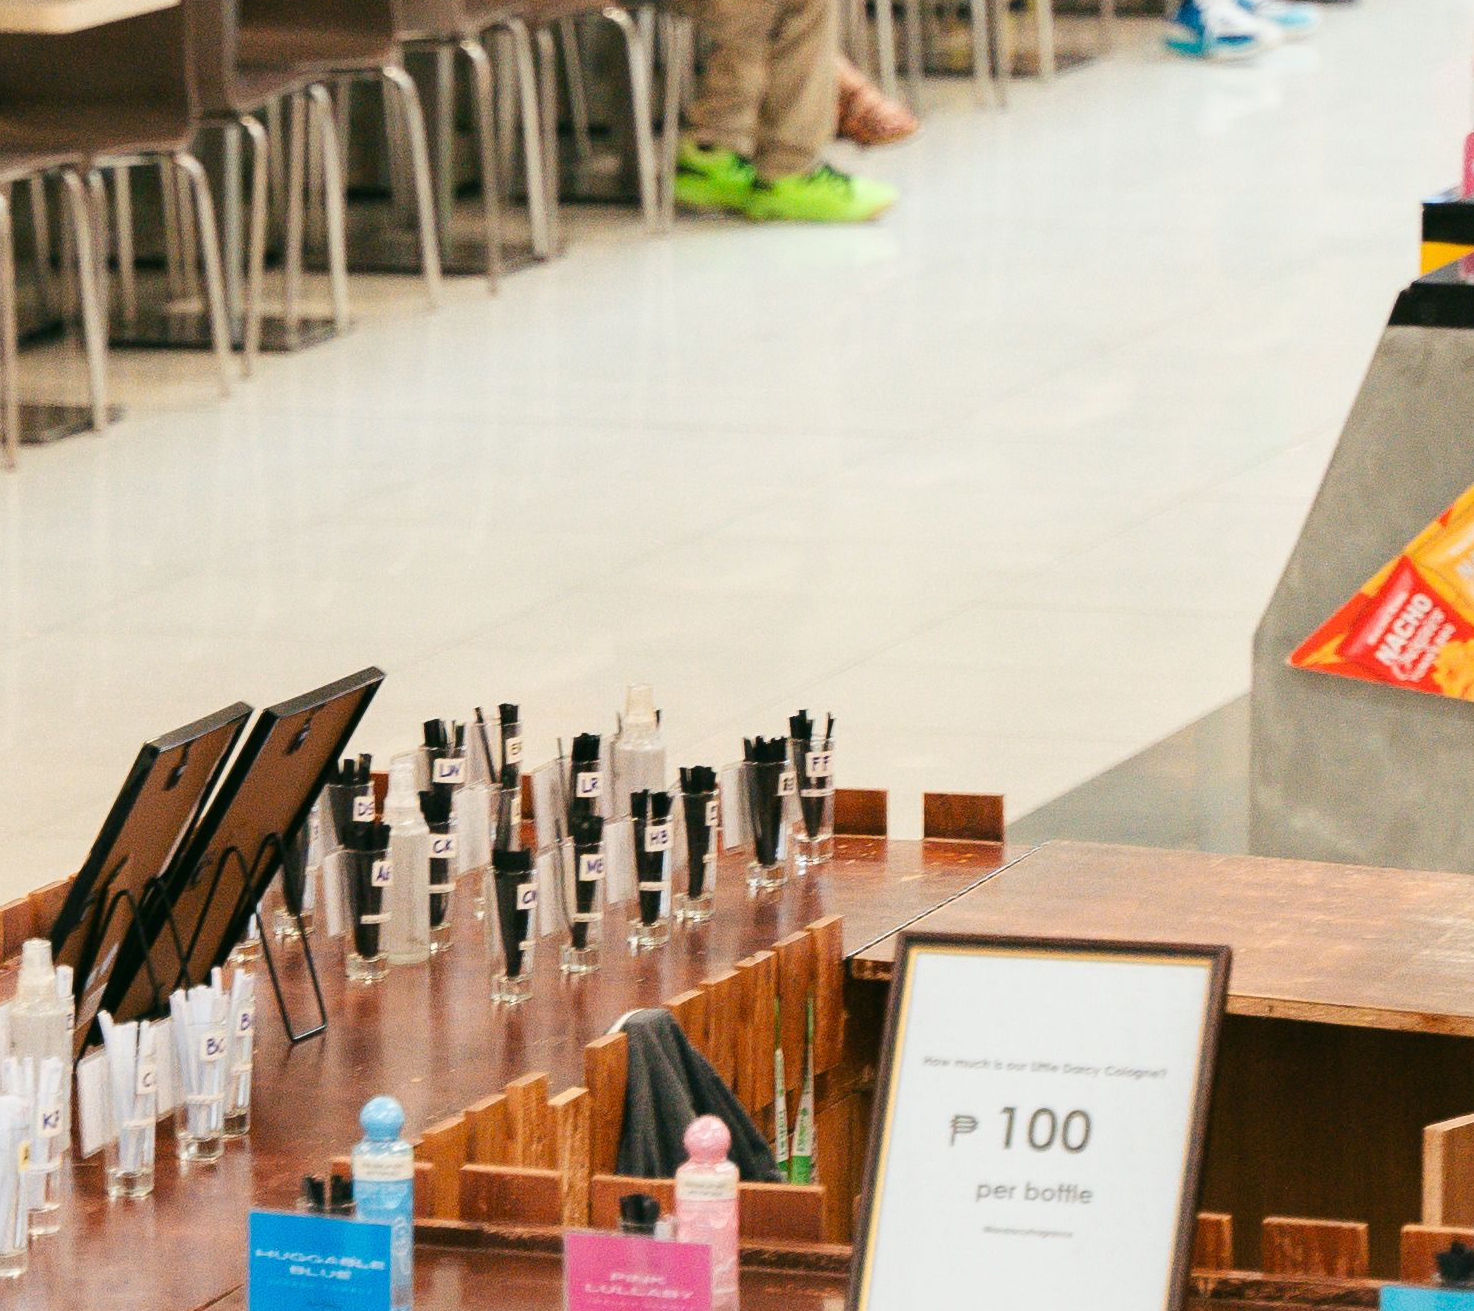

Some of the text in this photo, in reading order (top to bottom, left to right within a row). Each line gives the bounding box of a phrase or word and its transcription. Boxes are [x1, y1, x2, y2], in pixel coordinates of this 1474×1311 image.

[1374, 592, 1434, 666] NACHO
[923, 1055, 951, 1069] How
[954, 1057, 990, 1070] much
[999, 1104, 1093, 1155] 100
[975, 1180, 1095, 1205] per bottle
[253, 1248, 387, 1271] HUGGABLE
[288, 1264, 352, 1281] BLUE
